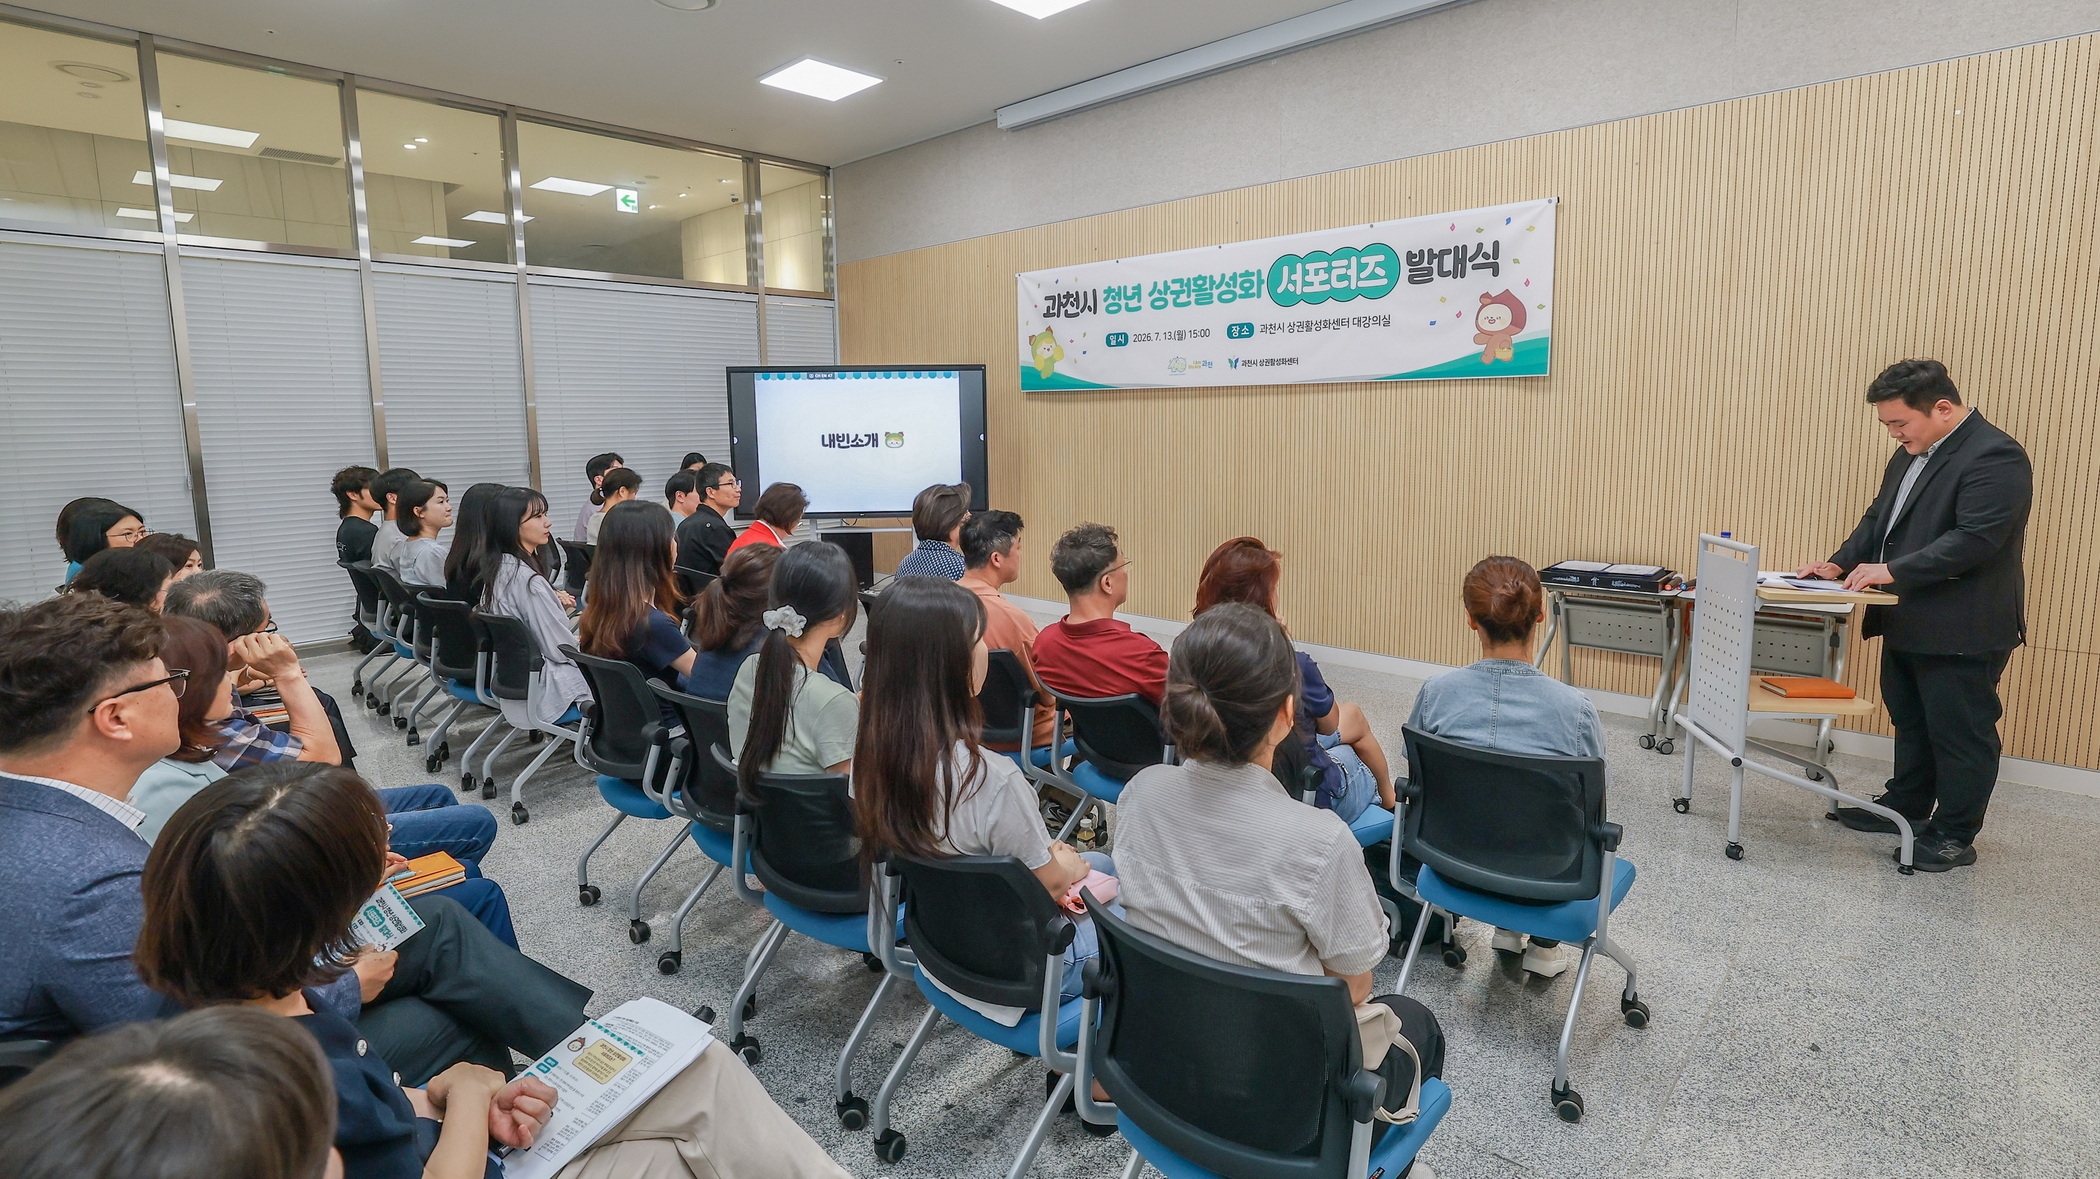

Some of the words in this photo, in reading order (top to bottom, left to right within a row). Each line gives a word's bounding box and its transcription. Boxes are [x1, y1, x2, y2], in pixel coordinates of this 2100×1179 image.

[1043, 288, 1097, 318] 과천시
[1102, 282, 1142, 315] 청년
[1148, 269, 1266, 309] 상권활성화
[1276, 254, 1389, 295] 서포터즈
[1405, 240, 1500, 285] 발대식
[1231, 325, 1250, 337] 장소
[1259, 322, 1285, 335] 과천시
[1287, 317, 1350, 334] 상권활성화센터
[1352, 314, 1391, 328] 대강의실
[1109, 334, 1125, 346] 일시
[1133, 333, 1154, 343] 2026.
[1155, 332, 1162, 341] 7.
[1188, 328, 1211, 339] 15:00
[1241, 359, 1258, 368] 과천시
[1259, 357, 1299, 367] 상권활성화센터
[821, 432, 879, 449] 내빈소개
